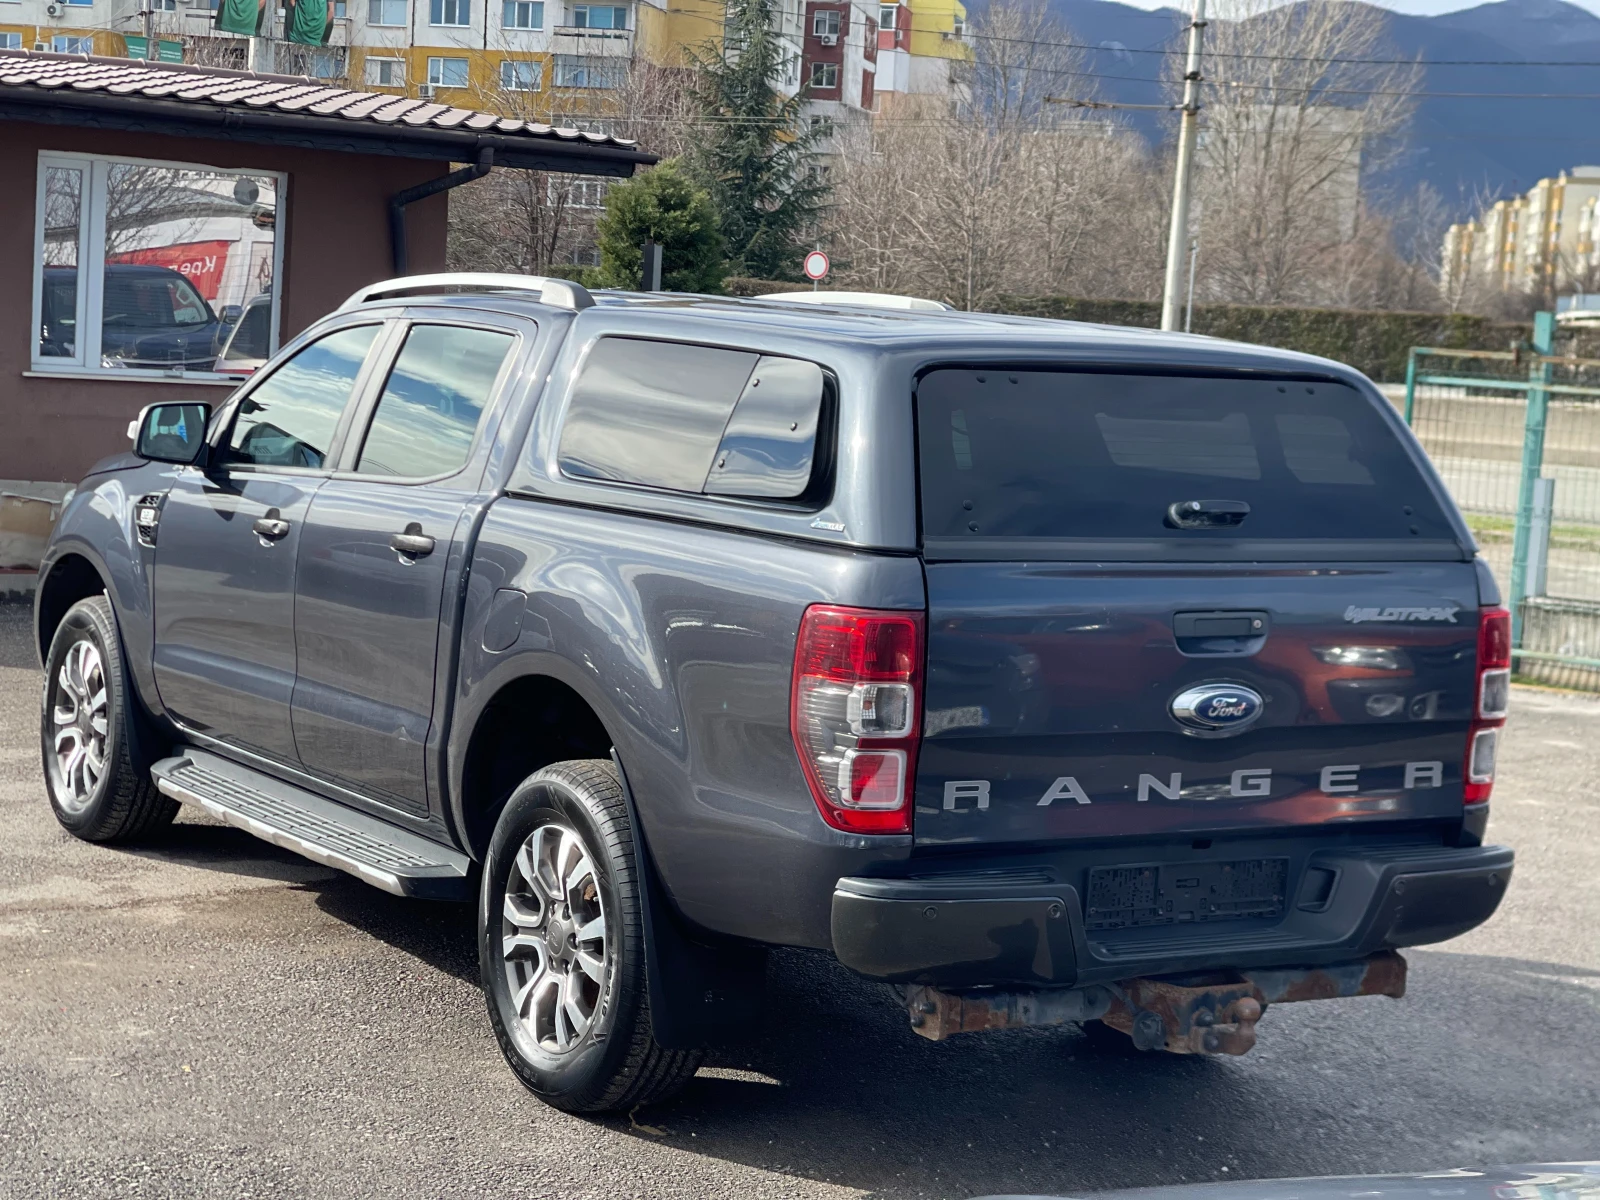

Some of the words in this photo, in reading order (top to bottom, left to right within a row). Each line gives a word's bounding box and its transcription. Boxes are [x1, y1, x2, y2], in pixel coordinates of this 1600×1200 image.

[1344, 605, 1460, 624] WILDTRAK
[1208, 697, 1246, 717] Ford
[943, 760, 1443, 810] RANGER
